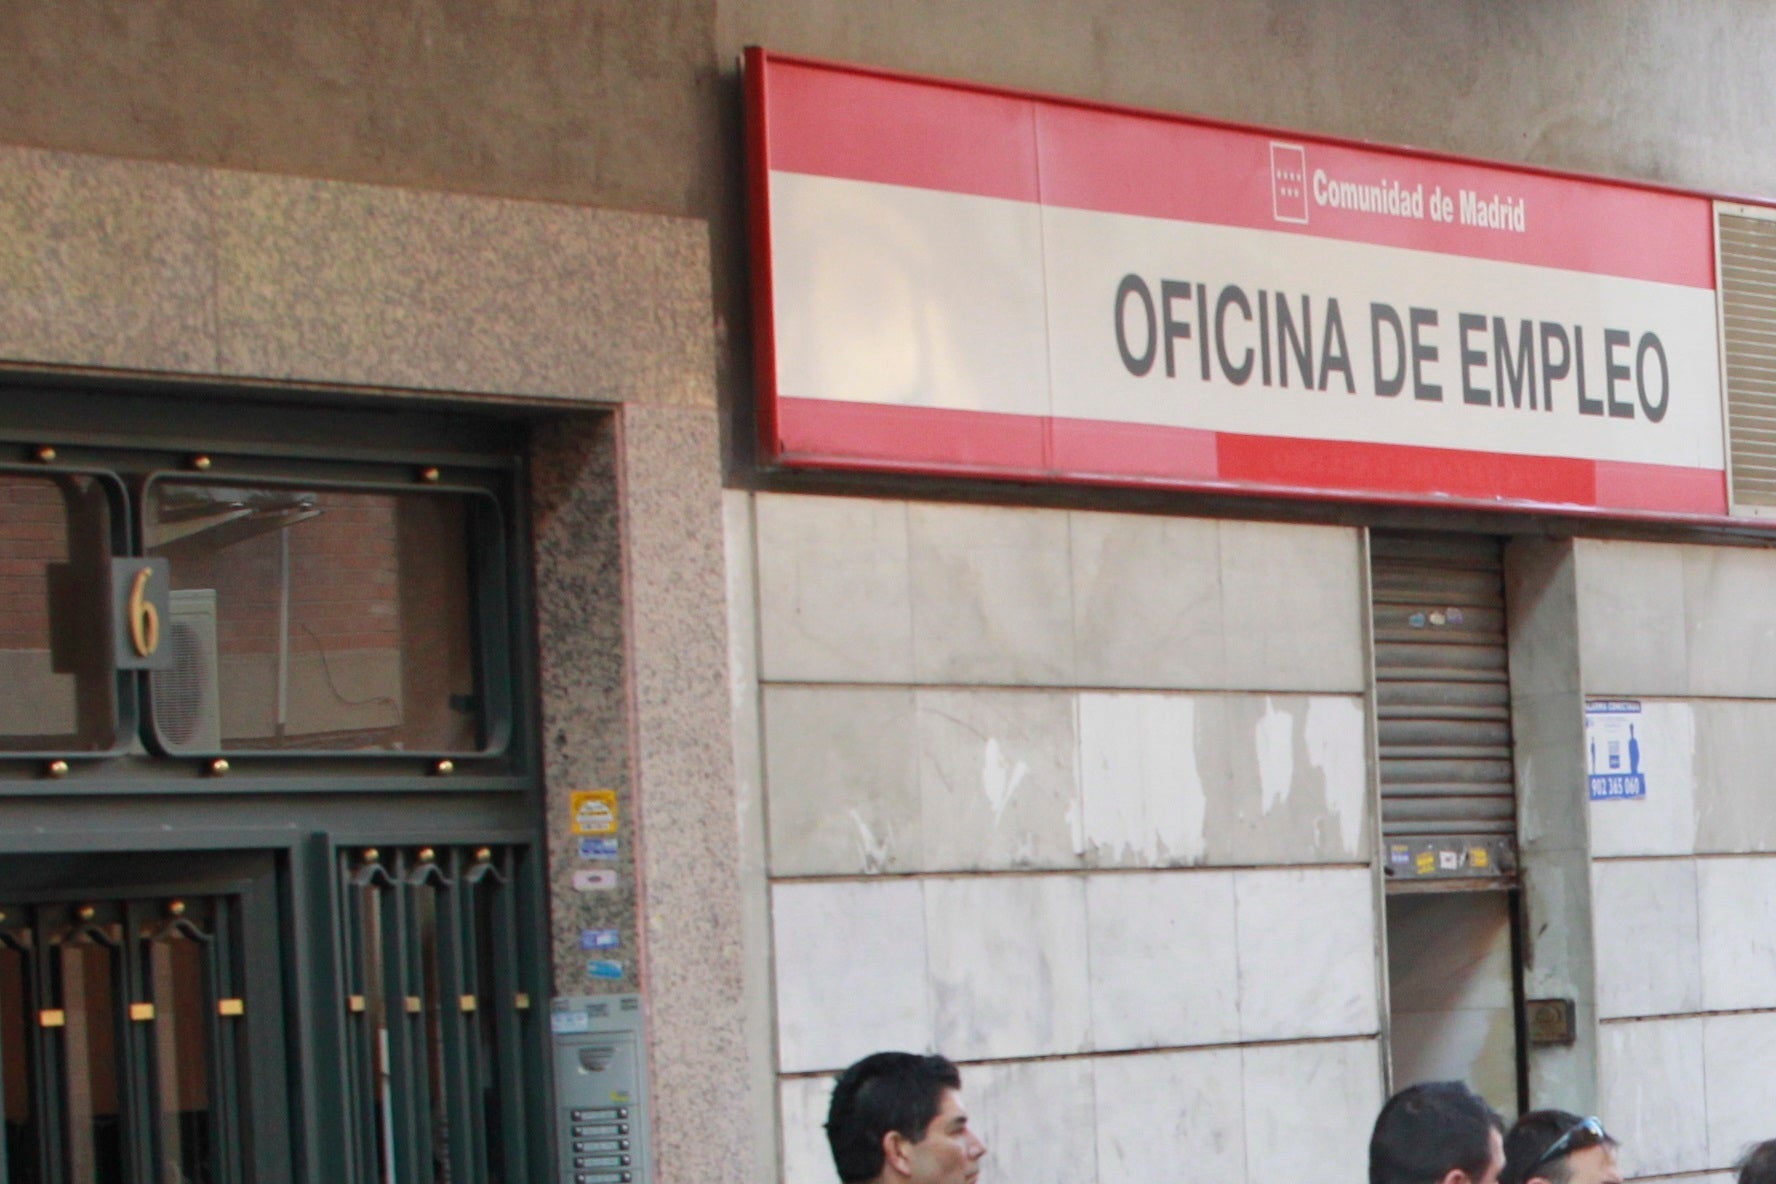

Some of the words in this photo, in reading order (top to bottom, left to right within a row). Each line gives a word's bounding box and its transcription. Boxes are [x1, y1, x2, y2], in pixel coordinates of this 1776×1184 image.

[1313, 169, 1424, 219] Comunidad
[1430, 186, 1454, 223] de
[1459, 189, 1526, 233] Madrid
[1114, 273, 1357, 395] OFICINA
[1370, 302, 1443, 402] DE
[1458, 312, 1670, 424] EMPLEO
[128, 566, 161, 659] 6
